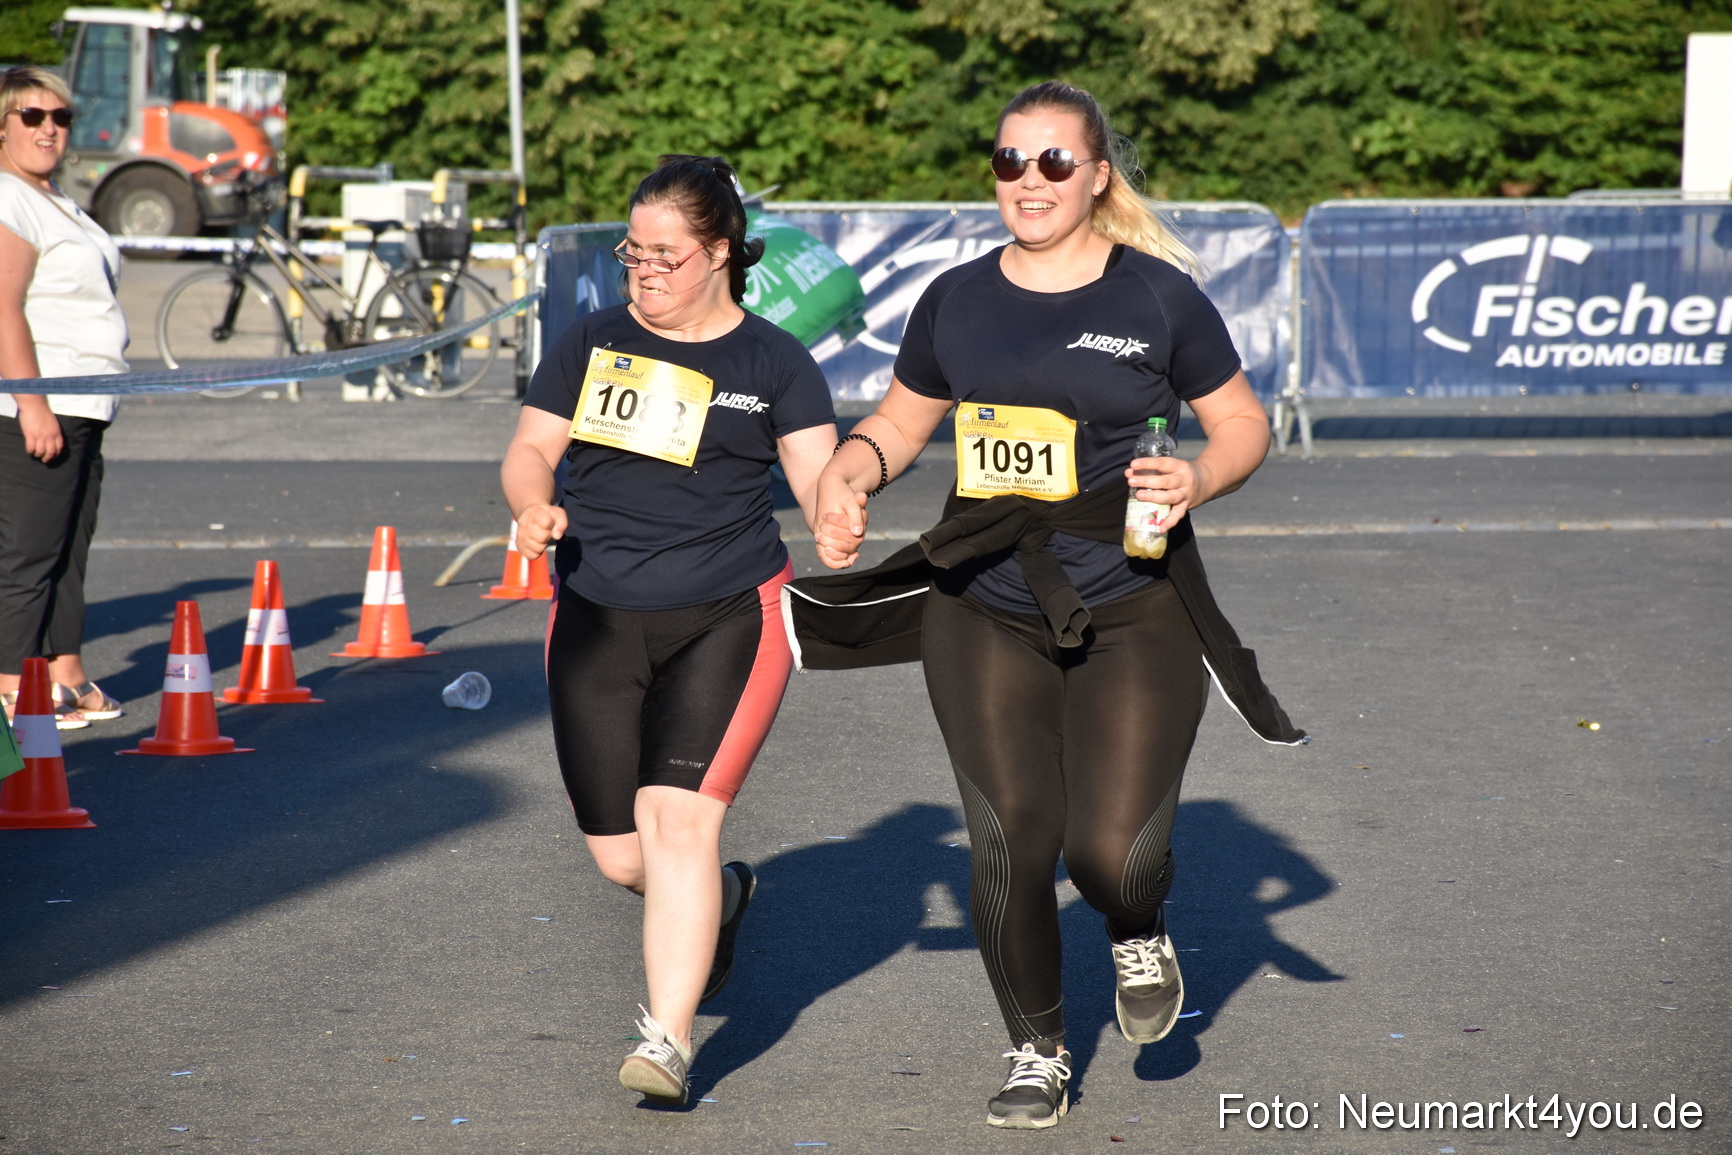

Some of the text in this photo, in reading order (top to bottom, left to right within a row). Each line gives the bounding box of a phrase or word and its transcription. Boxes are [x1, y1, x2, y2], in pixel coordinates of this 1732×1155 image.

[1066, 333, 1126, 351] JURA
[1495, 343, 1727, 367] AUTOMOBILE
[604, 365, 645, 380] firmenlauf
[708, 391, 759, 408] JURA
[971, 418, 1010, 429] firmenlauf
[973, 437, 1053, 476] 1091
[976, 482, 1010, 490] Lebenshilfe
[984, 473, 1046, 486] Pfister Miriam
